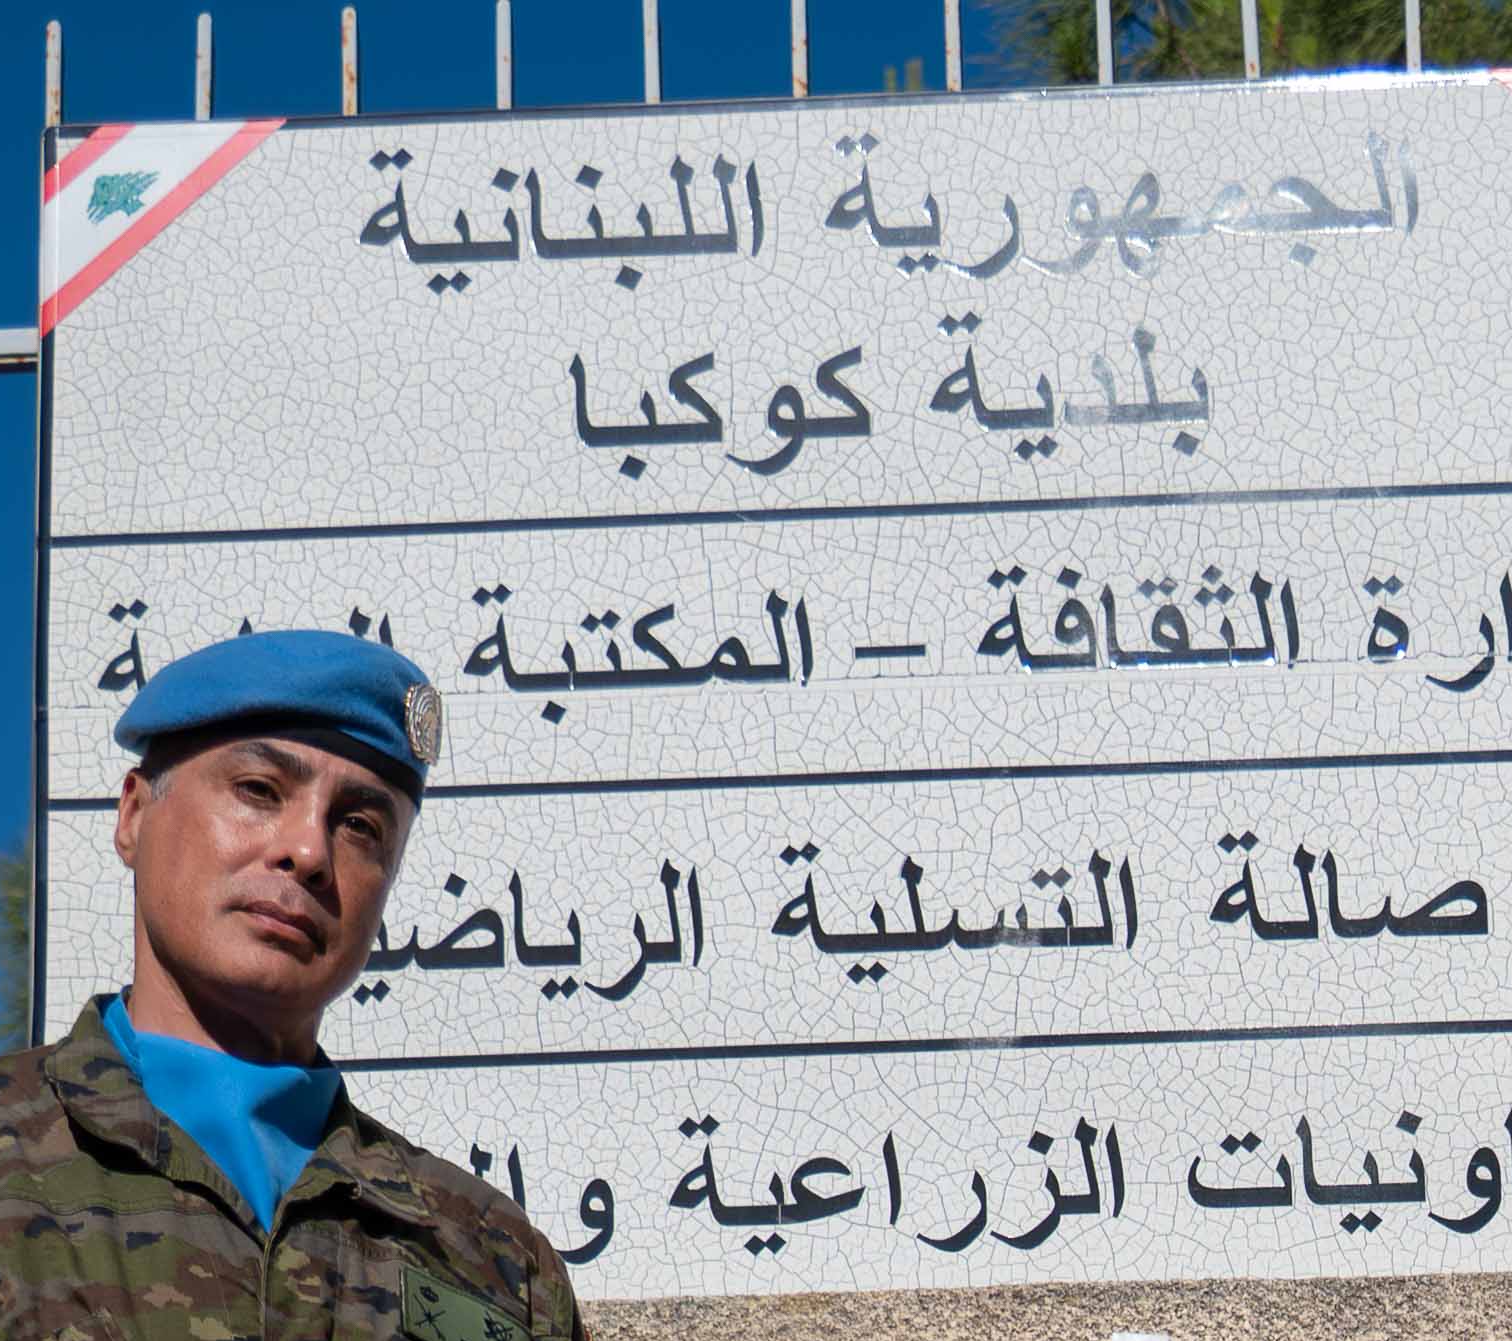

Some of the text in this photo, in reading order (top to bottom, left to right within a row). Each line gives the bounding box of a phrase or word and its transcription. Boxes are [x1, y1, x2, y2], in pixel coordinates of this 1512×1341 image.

[359, 132, 1420, 296] الجمهورية اللبنانية
[568, 310, 1211, 480] بلدية كوكبا
[463, 584, 813, 725] المكتبة
[976, 565, 1300, 671] الثقافة
[353, 830, 1489, 1005] صالة التسلية الرياضي
[669, 1113, 1125, 1257] الزراعية
